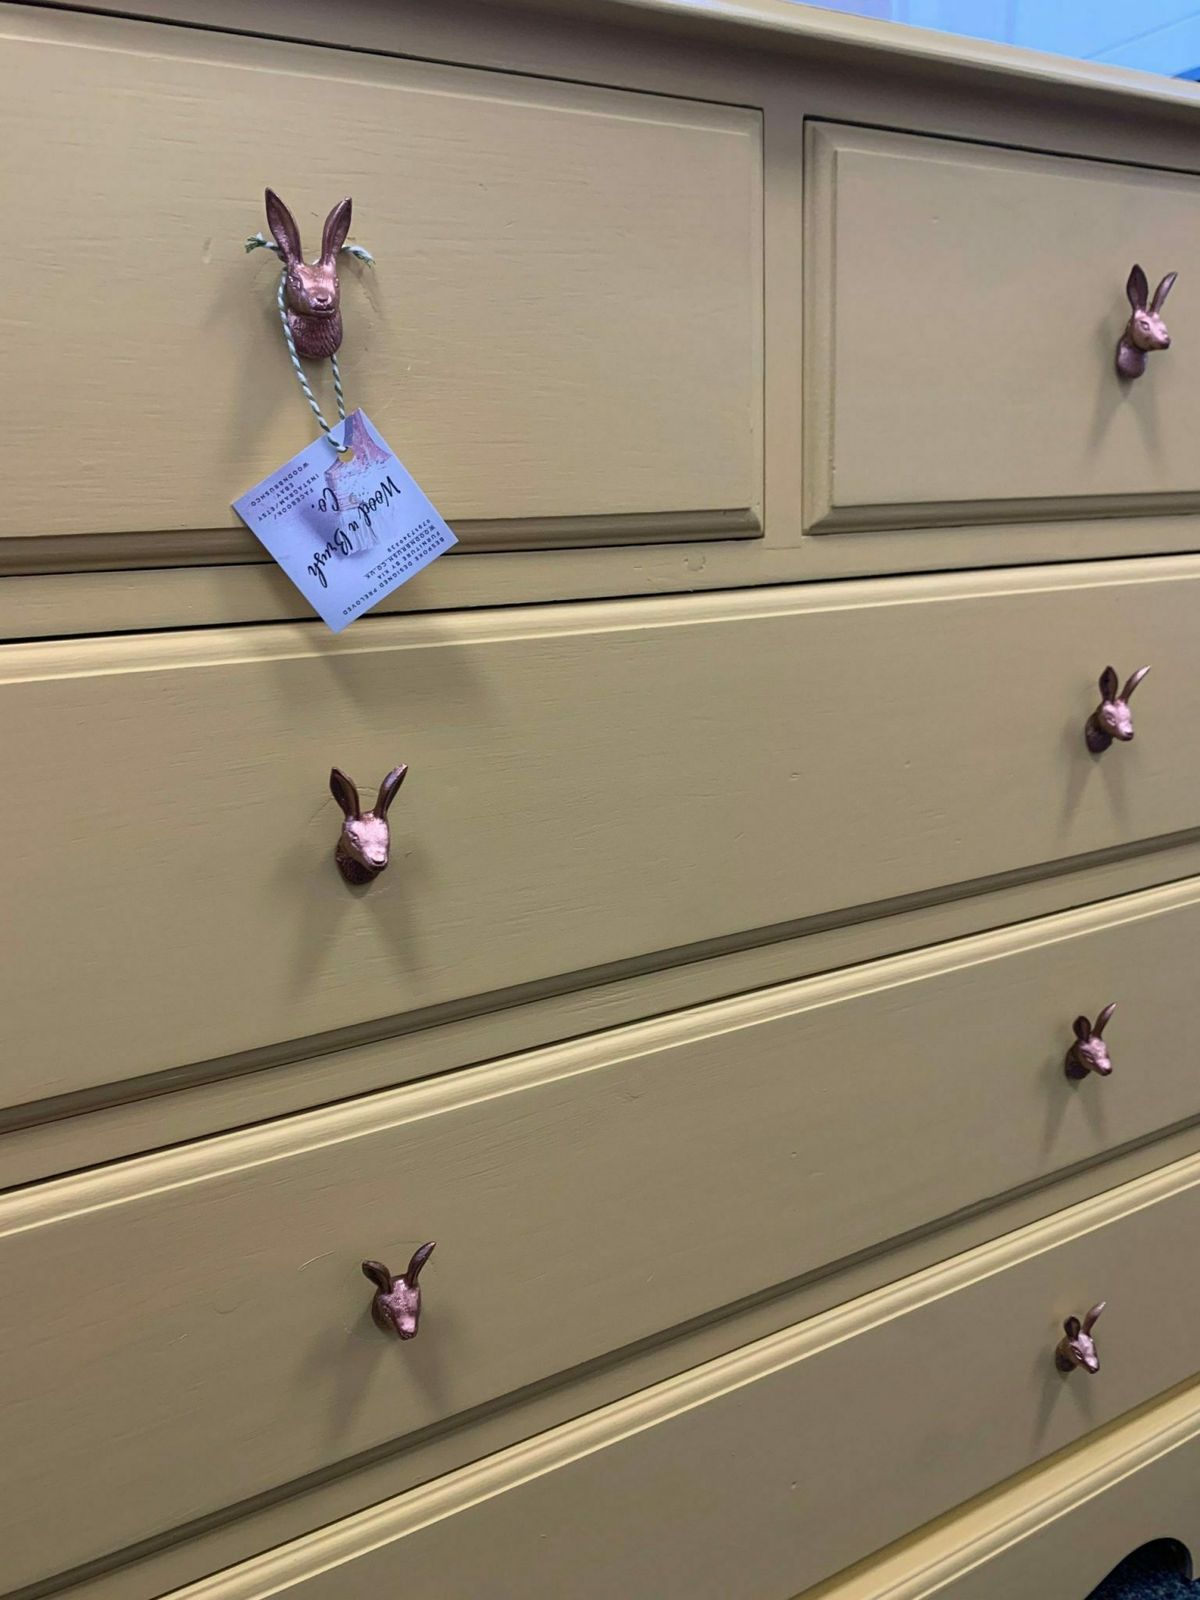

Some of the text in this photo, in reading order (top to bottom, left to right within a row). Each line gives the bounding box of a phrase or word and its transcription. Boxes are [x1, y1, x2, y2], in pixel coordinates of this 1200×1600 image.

[250, 461, 309, 506] WOODNBRUSHCO
[275, 482, 294, 498] EBAY
[311, 487, 339, 512] Co.
[307, 476, 400, 588] Wood n Brush
[402, 530, 440, 561] FURNITURE
[342, 536, 444, 615] BESPOKE DESIGNED PRELOVED
[391, 560, 400, 569] BY
